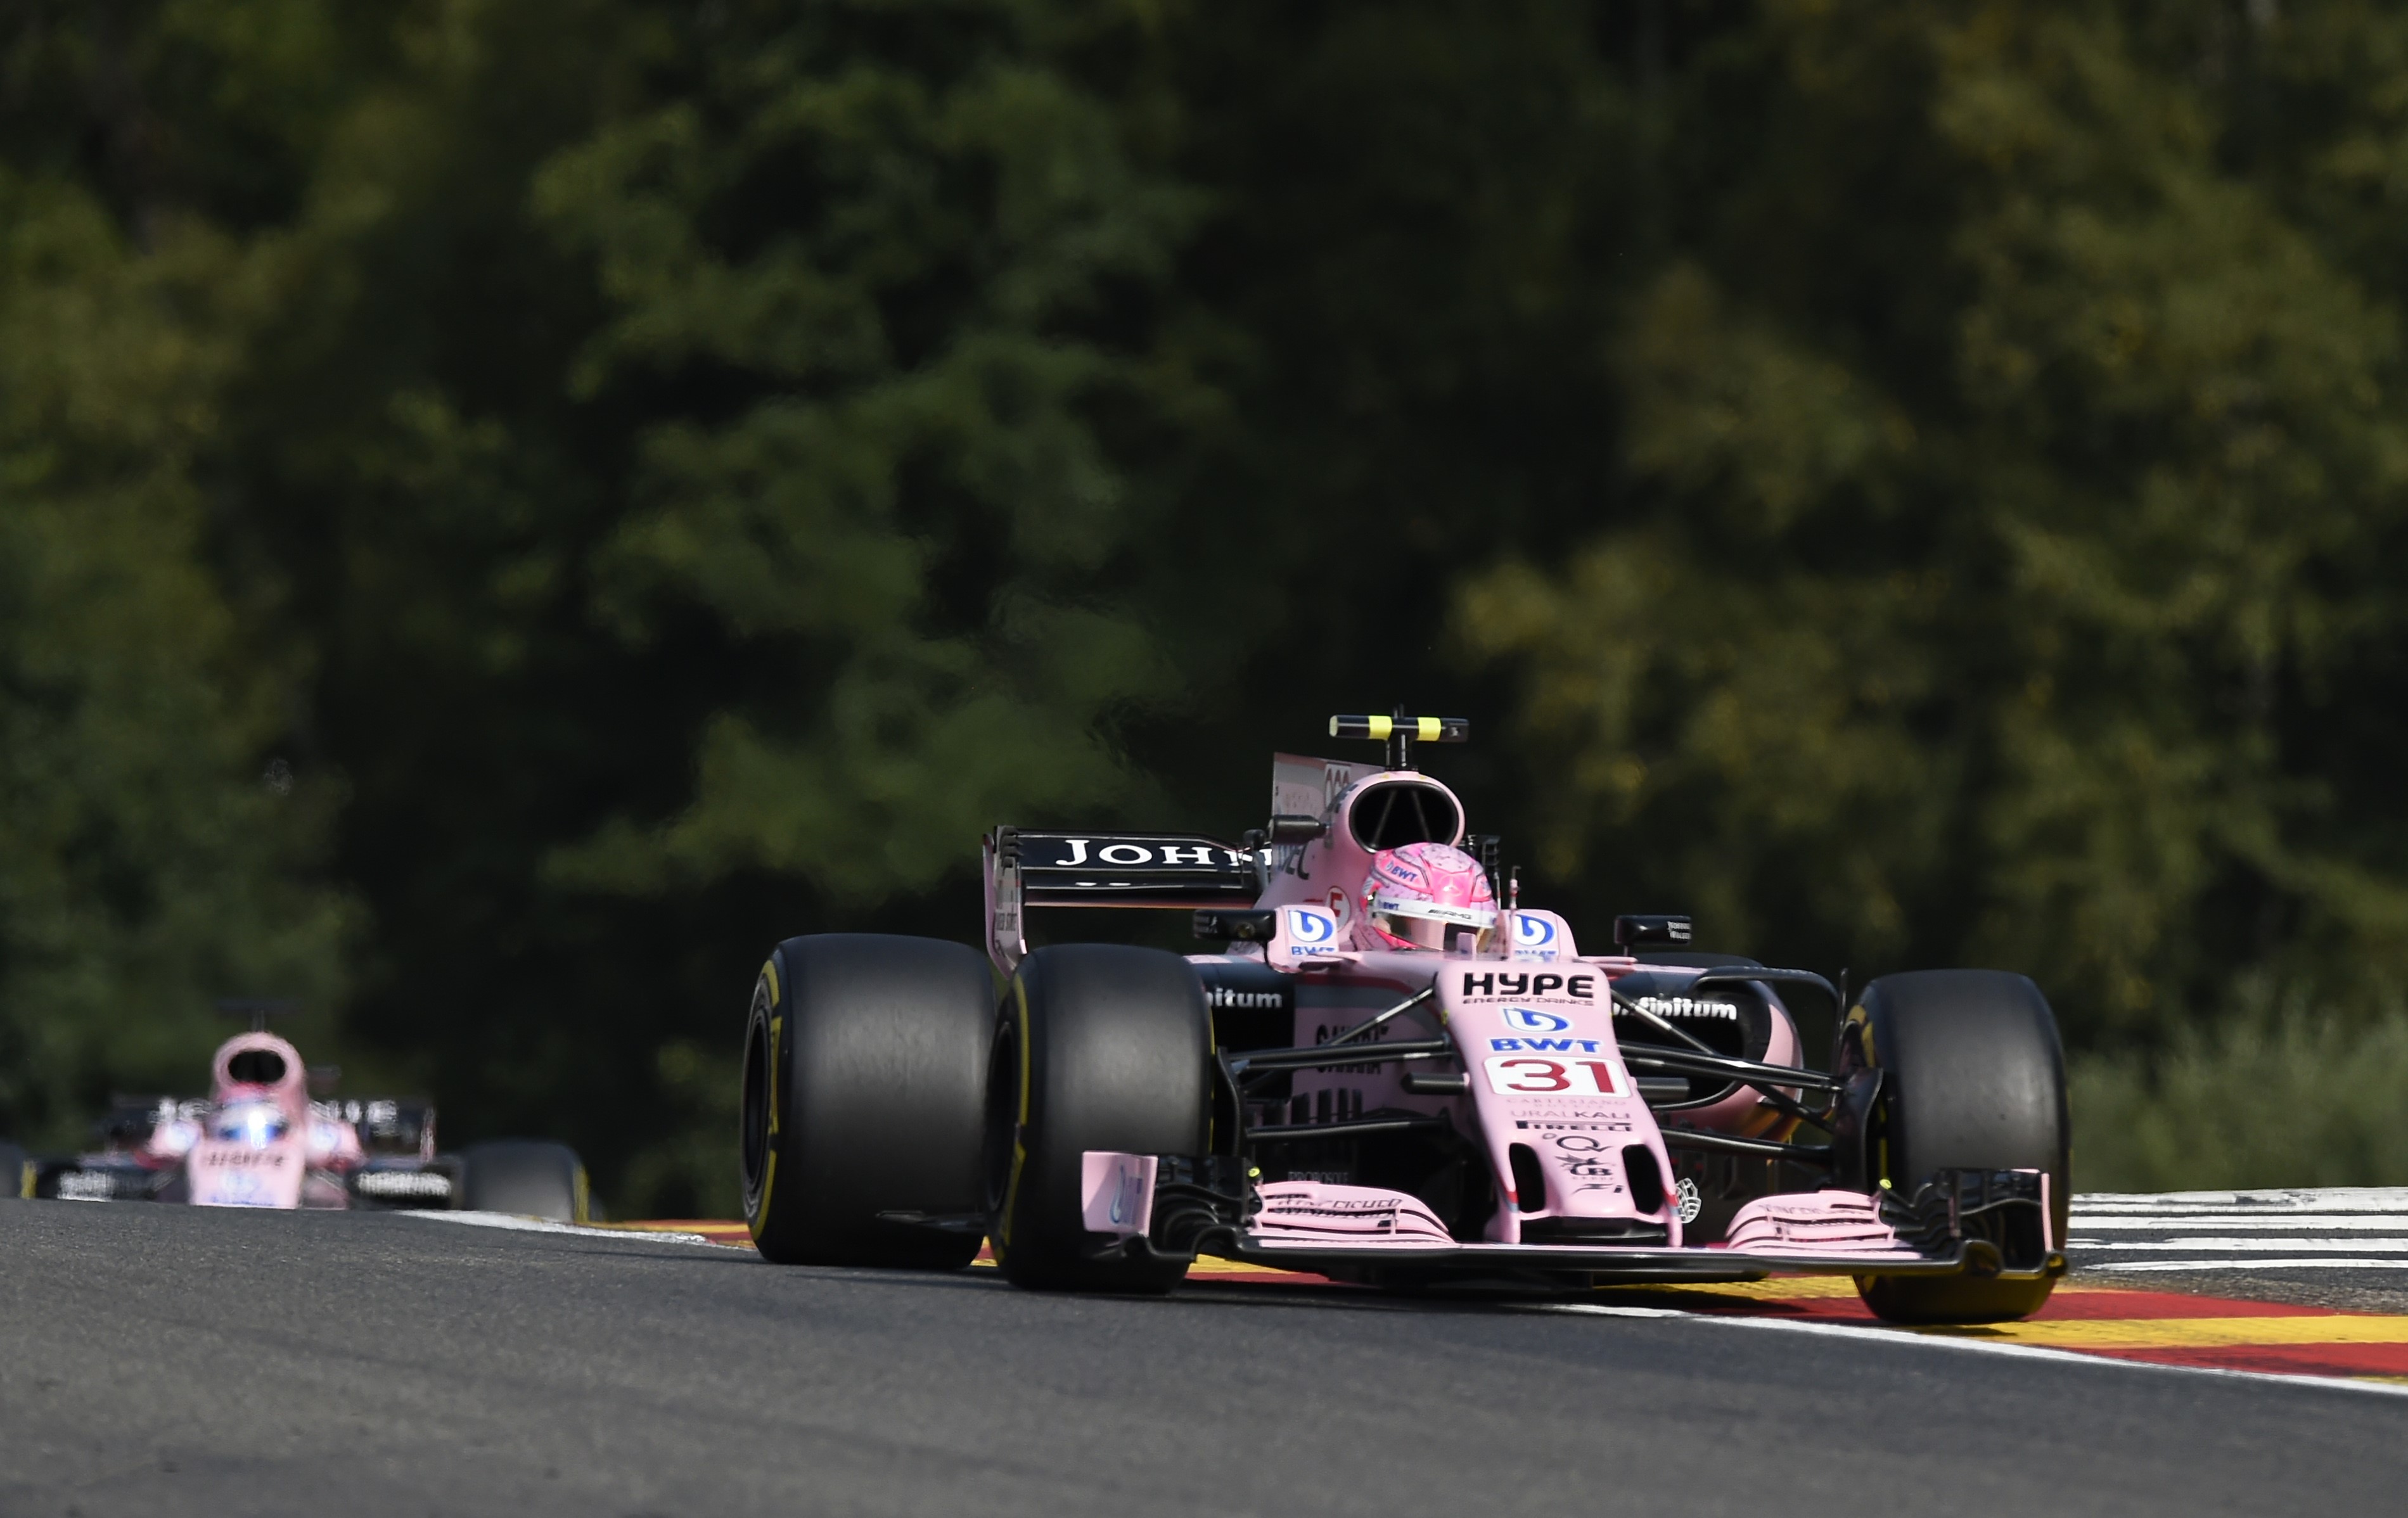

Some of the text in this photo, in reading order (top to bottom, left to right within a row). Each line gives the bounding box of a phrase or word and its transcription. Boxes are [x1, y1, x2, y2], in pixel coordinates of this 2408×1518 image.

[1391, 866, 1418, 882] BWT
[1463, 973, 1595, 998] HYPE
[1537, 997, 1594, 1006] DRINKS
[1490, 1038, 1601, 1053] BWT
[1500, 1059, 1615, 1094] 31
[1511, 1111, 1630, 1119] URALKALI
